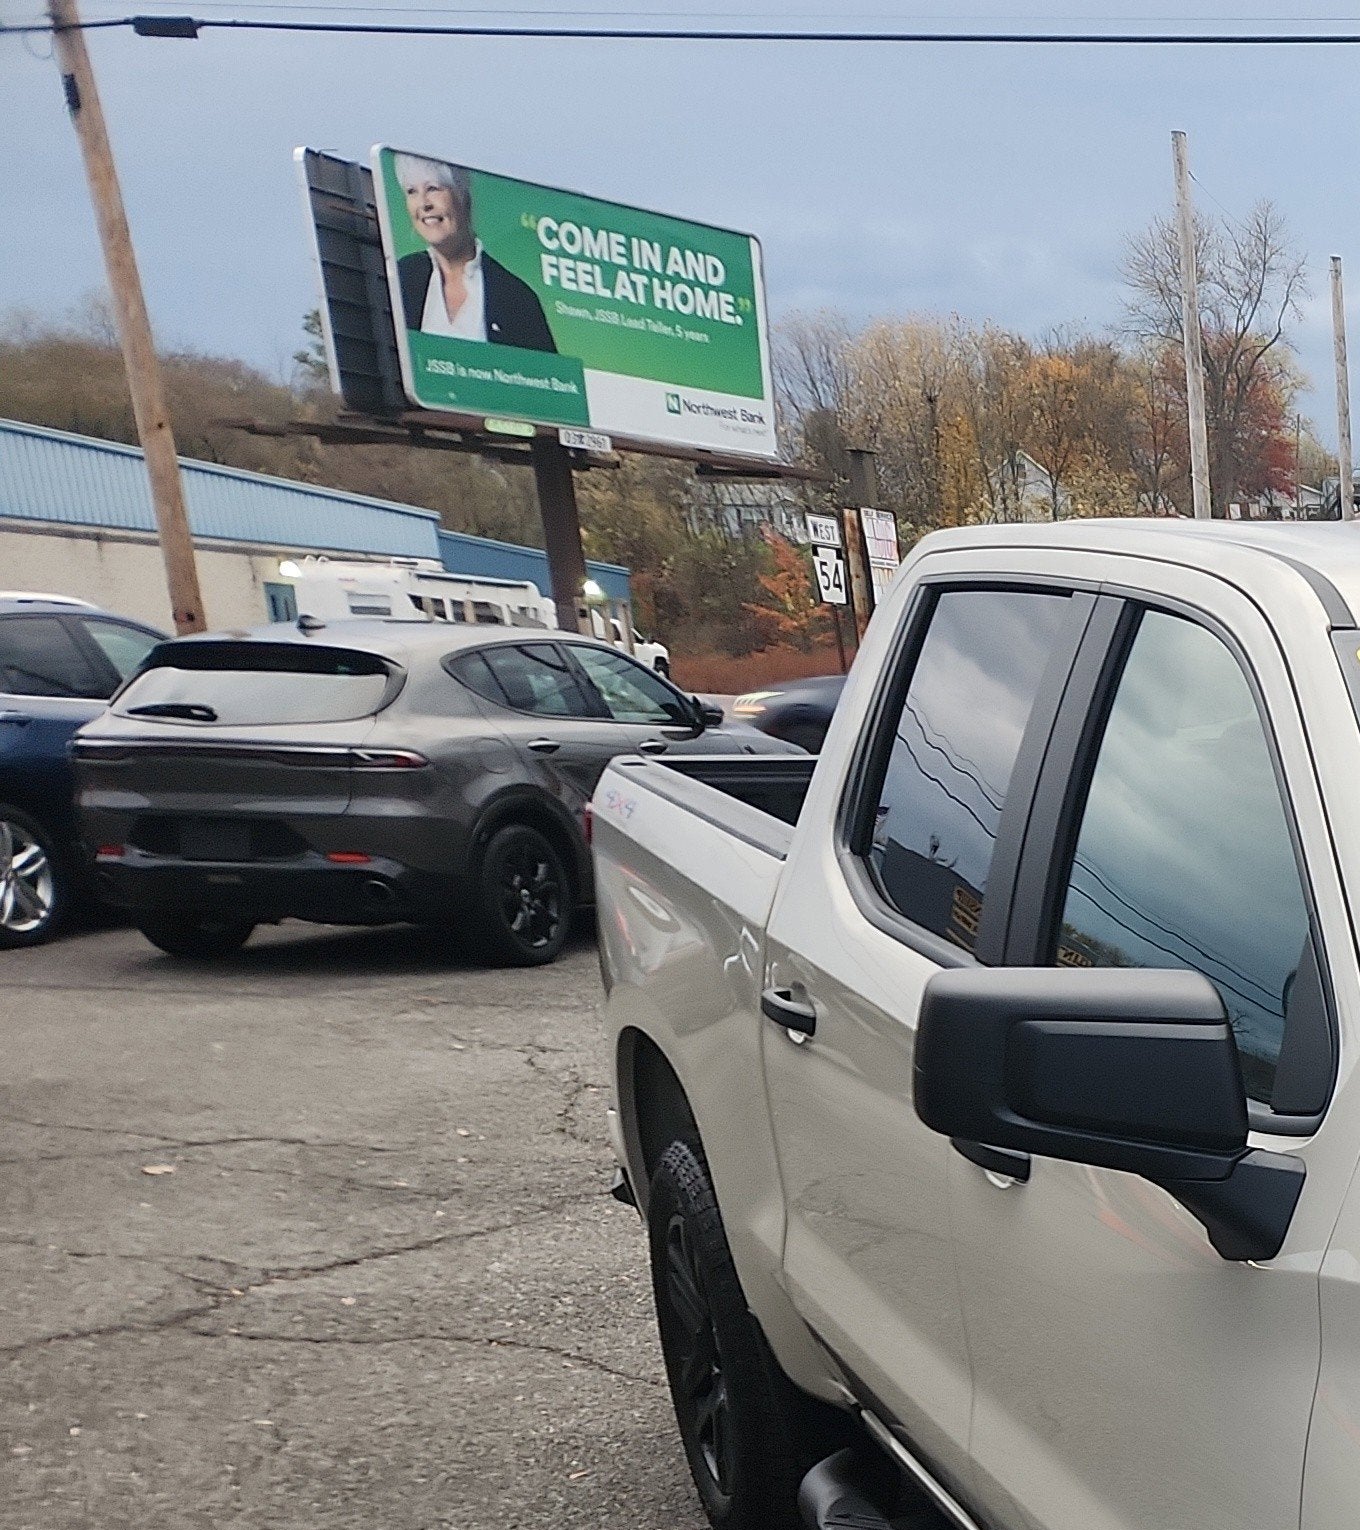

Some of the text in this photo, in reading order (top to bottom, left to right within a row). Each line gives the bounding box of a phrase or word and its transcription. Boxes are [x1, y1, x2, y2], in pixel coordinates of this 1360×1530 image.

[631, 236, 663, 274] IN
[665, 246, 727, 286] AND
[540, 253, 613, 299] FEEL
[613, 269, 650, 306] AT
[675, 324, 685, 339] 5
[455, 362, 468, 378] is
[467, 367, 493, 382] now
[493, 368, 552, 391] Northwest
[550, 376, 581, 395] Bank
[682, 398, 767, 425] Northwest Bank
[811, 519, 836, 541] WEST
[819, 560, 843, 593] 54
